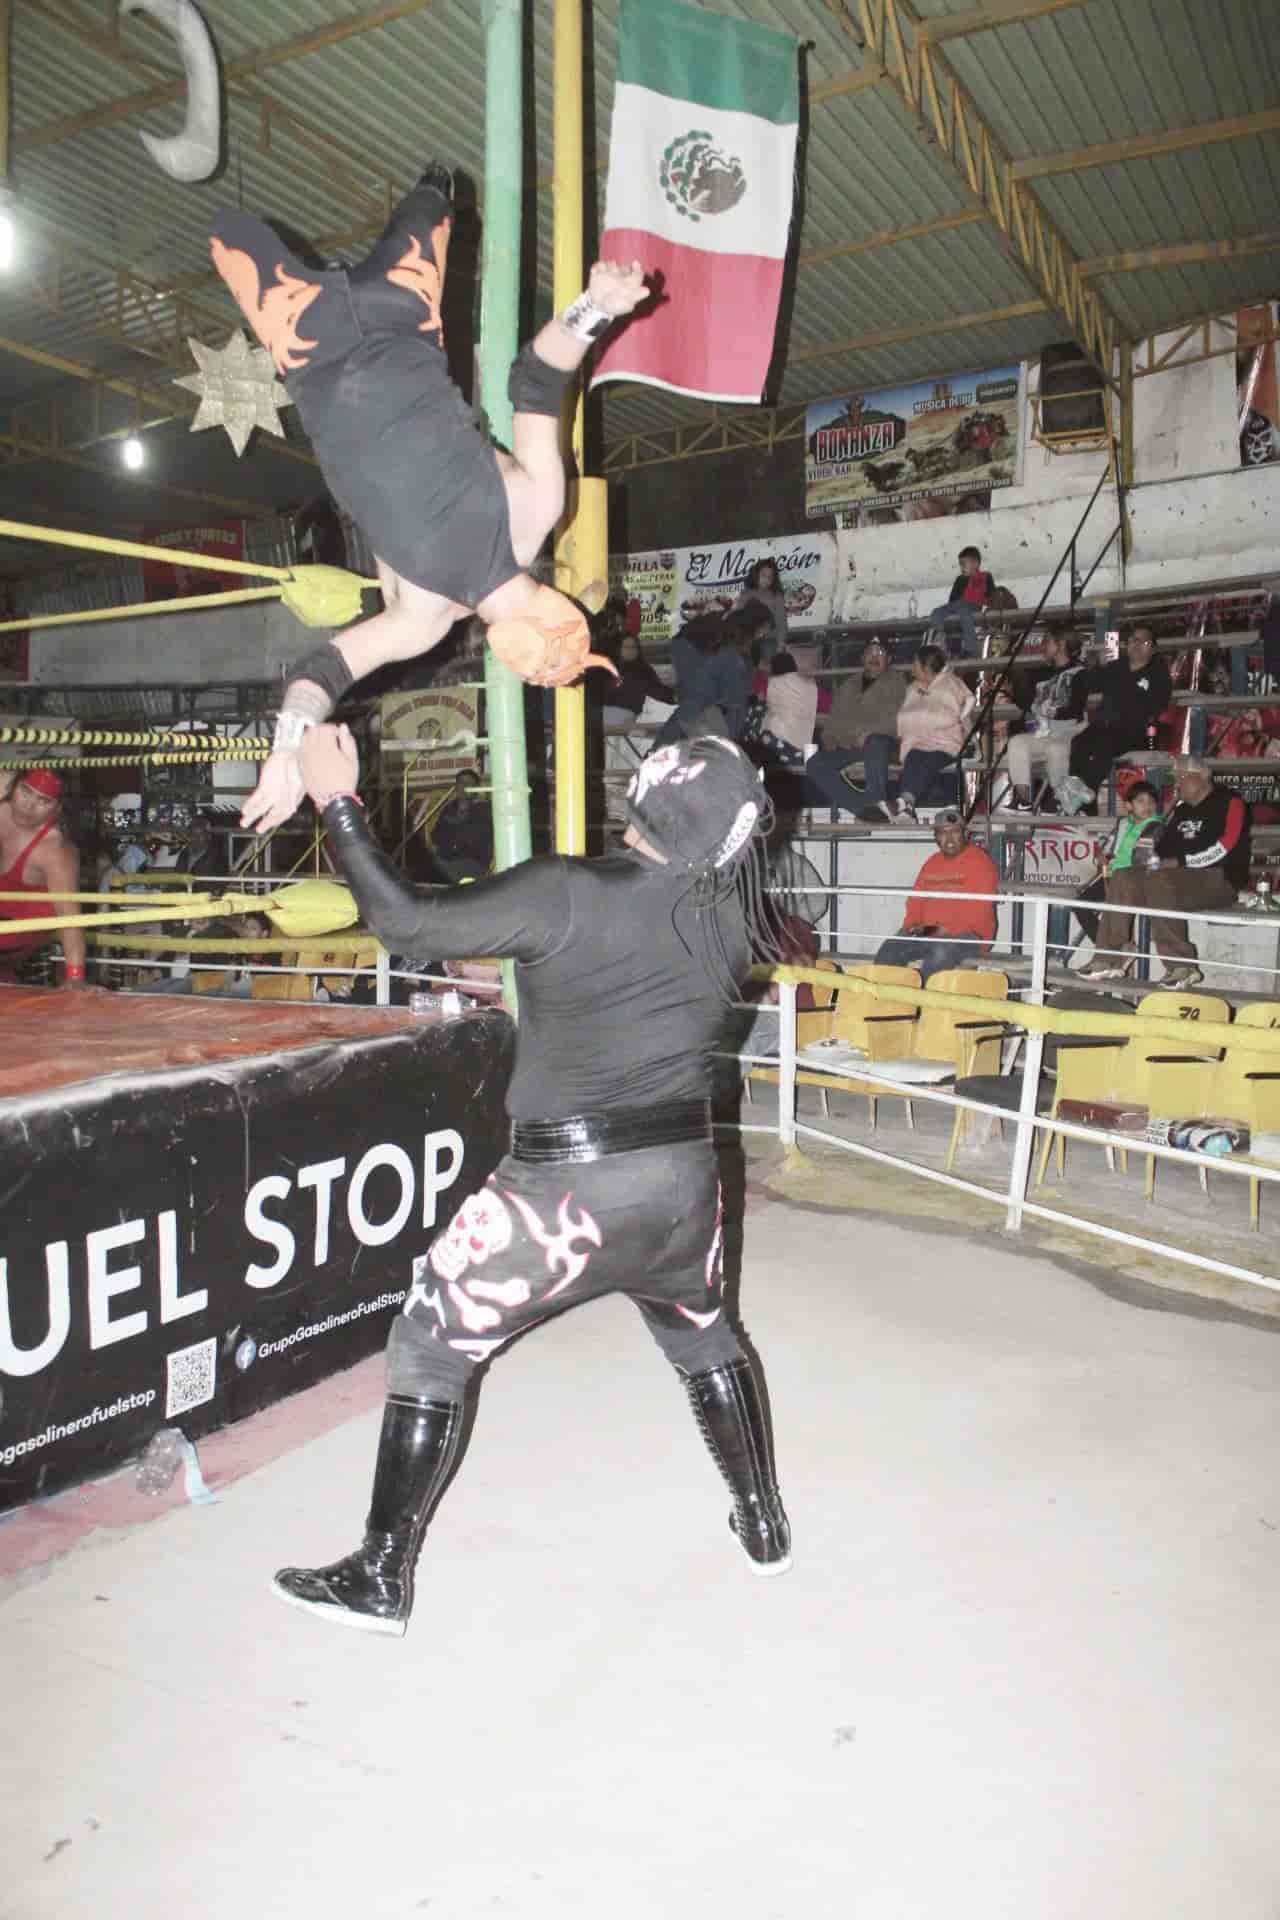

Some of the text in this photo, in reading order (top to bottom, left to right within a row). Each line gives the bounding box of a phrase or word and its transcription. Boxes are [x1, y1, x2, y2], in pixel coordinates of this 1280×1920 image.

[816, 421, 896, 464] BONANZA
[685, 551, 713, 581] El
[244, 1128, 465, 1289] STOP
[258, 1290, 407, 1359] GrupoGasolineroFuelStop
